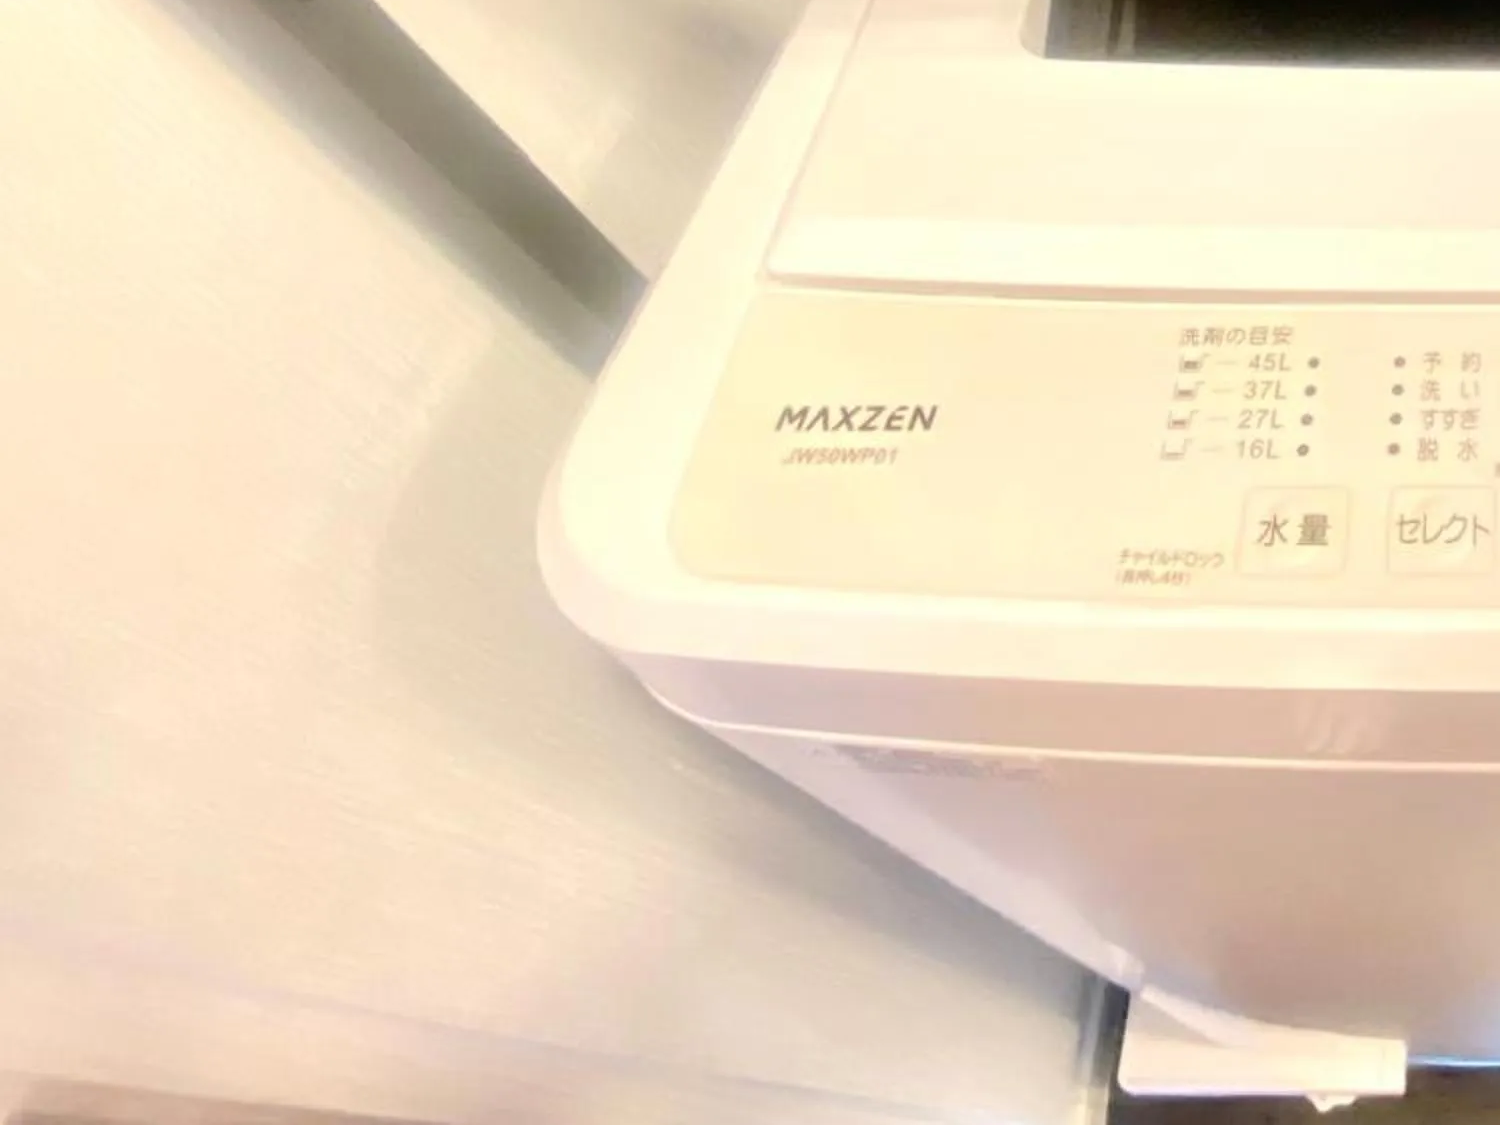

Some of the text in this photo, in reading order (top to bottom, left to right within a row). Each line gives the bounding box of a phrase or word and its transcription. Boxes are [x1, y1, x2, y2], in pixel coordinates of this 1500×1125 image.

[1178, 326, 1295, 348] 洗剤の目安
[1248, 351, 1292, 373] 45L
[1242, 379, 1288, 401] 37L
[1420, 378, 1481, 403] 洗い
[775, 404, 939, 432] MAXZEN
[1236, 408, 1285, 431] 27L
[1419, 408, 1481, 432] すすぎ
[1235, 437, 1281, 460] 16L
[1417, 437, 1479, 462] 脱水
[1256, 512, 1332, 548] 水量
[1396, 512, 1491, 547] セレクト
